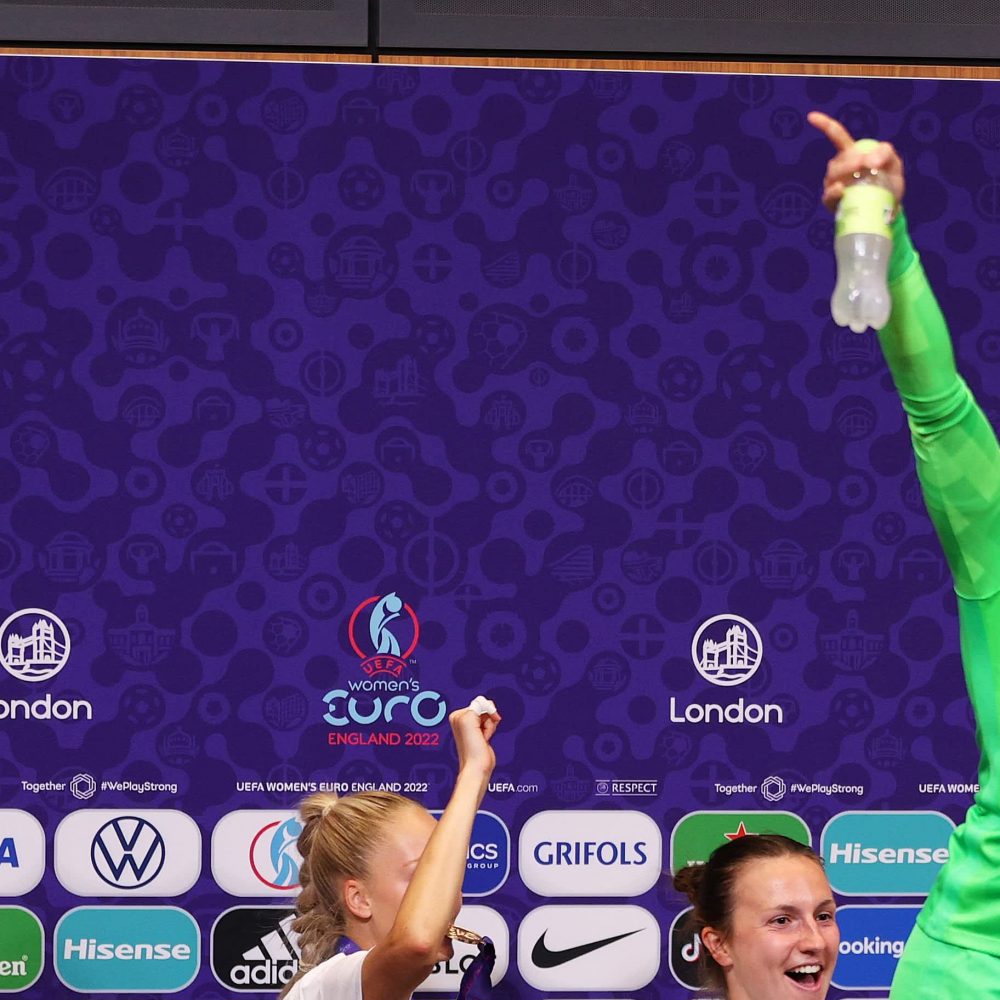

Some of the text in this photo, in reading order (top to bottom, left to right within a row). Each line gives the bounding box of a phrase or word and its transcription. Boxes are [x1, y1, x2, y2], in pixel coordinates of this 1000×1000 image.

[362, 660, 404, 676] UEFA
[348, 678, 419, 692] women's
[0, 694, 93, 720] ondon
[670, 697, 783, 723] London
[328, 733, 439, 746] ENGLAND 2022
[21, 780, 178, 793] Together #WePlayStrong
[236, 782, 428, 792] UEFA WOMEN'S EURO ENGLAND 2022
[488, 782, 538, 792] UEFA.com
[612, 783, 657, 793] RESPECT
[714, 783, 864, 795] Together #WePlayStrong
[919, 783, 980, 793] UEFA WOME
[533, 841, 648, 865] GRIFOLS
[829, 843, 949, 864] Hisense
[63, 939, 191, 961] Hisense
[839, 936, 904, 958] ooking
[230, 960, 298, 985] adid
